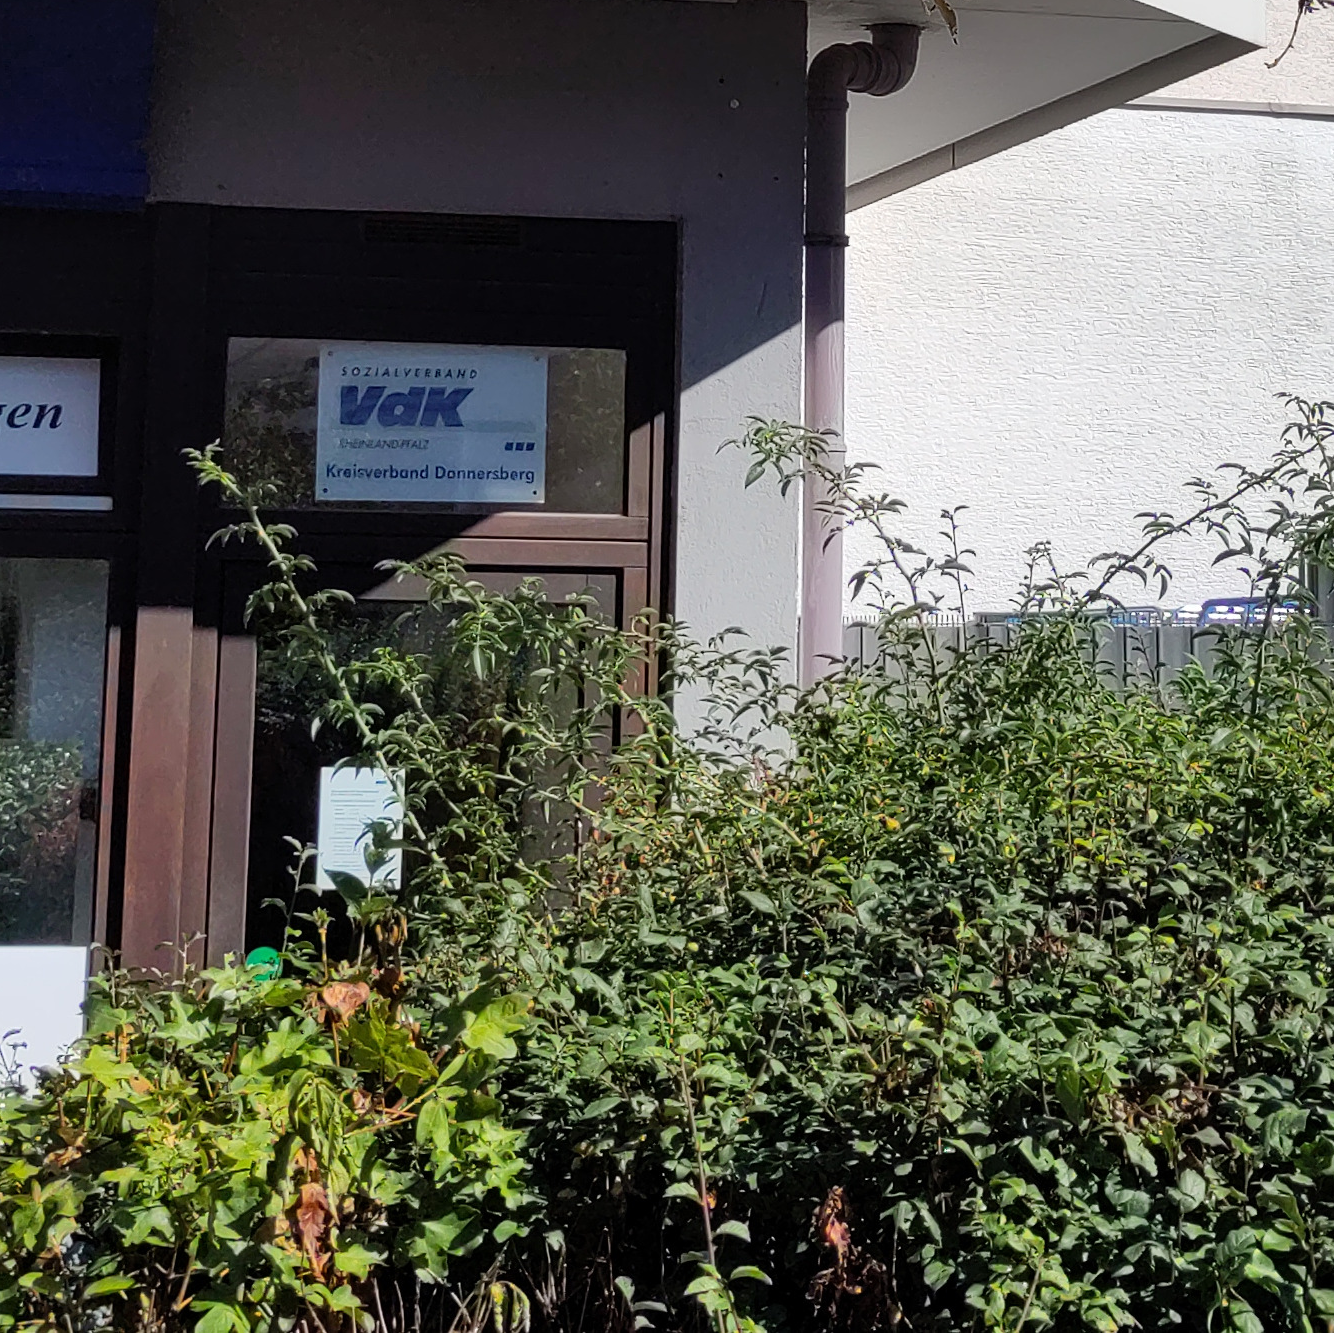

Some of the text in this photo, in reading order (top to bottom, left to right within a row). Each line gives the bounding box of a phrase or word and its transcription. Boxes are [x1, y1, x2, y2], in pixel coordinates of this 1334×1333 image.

[341, 365, 479, 380] SOZIALVERBAND
[339, 384, 475, 428] VdK
[325, 464, 536, 484] Kreisverband Donnersberg
